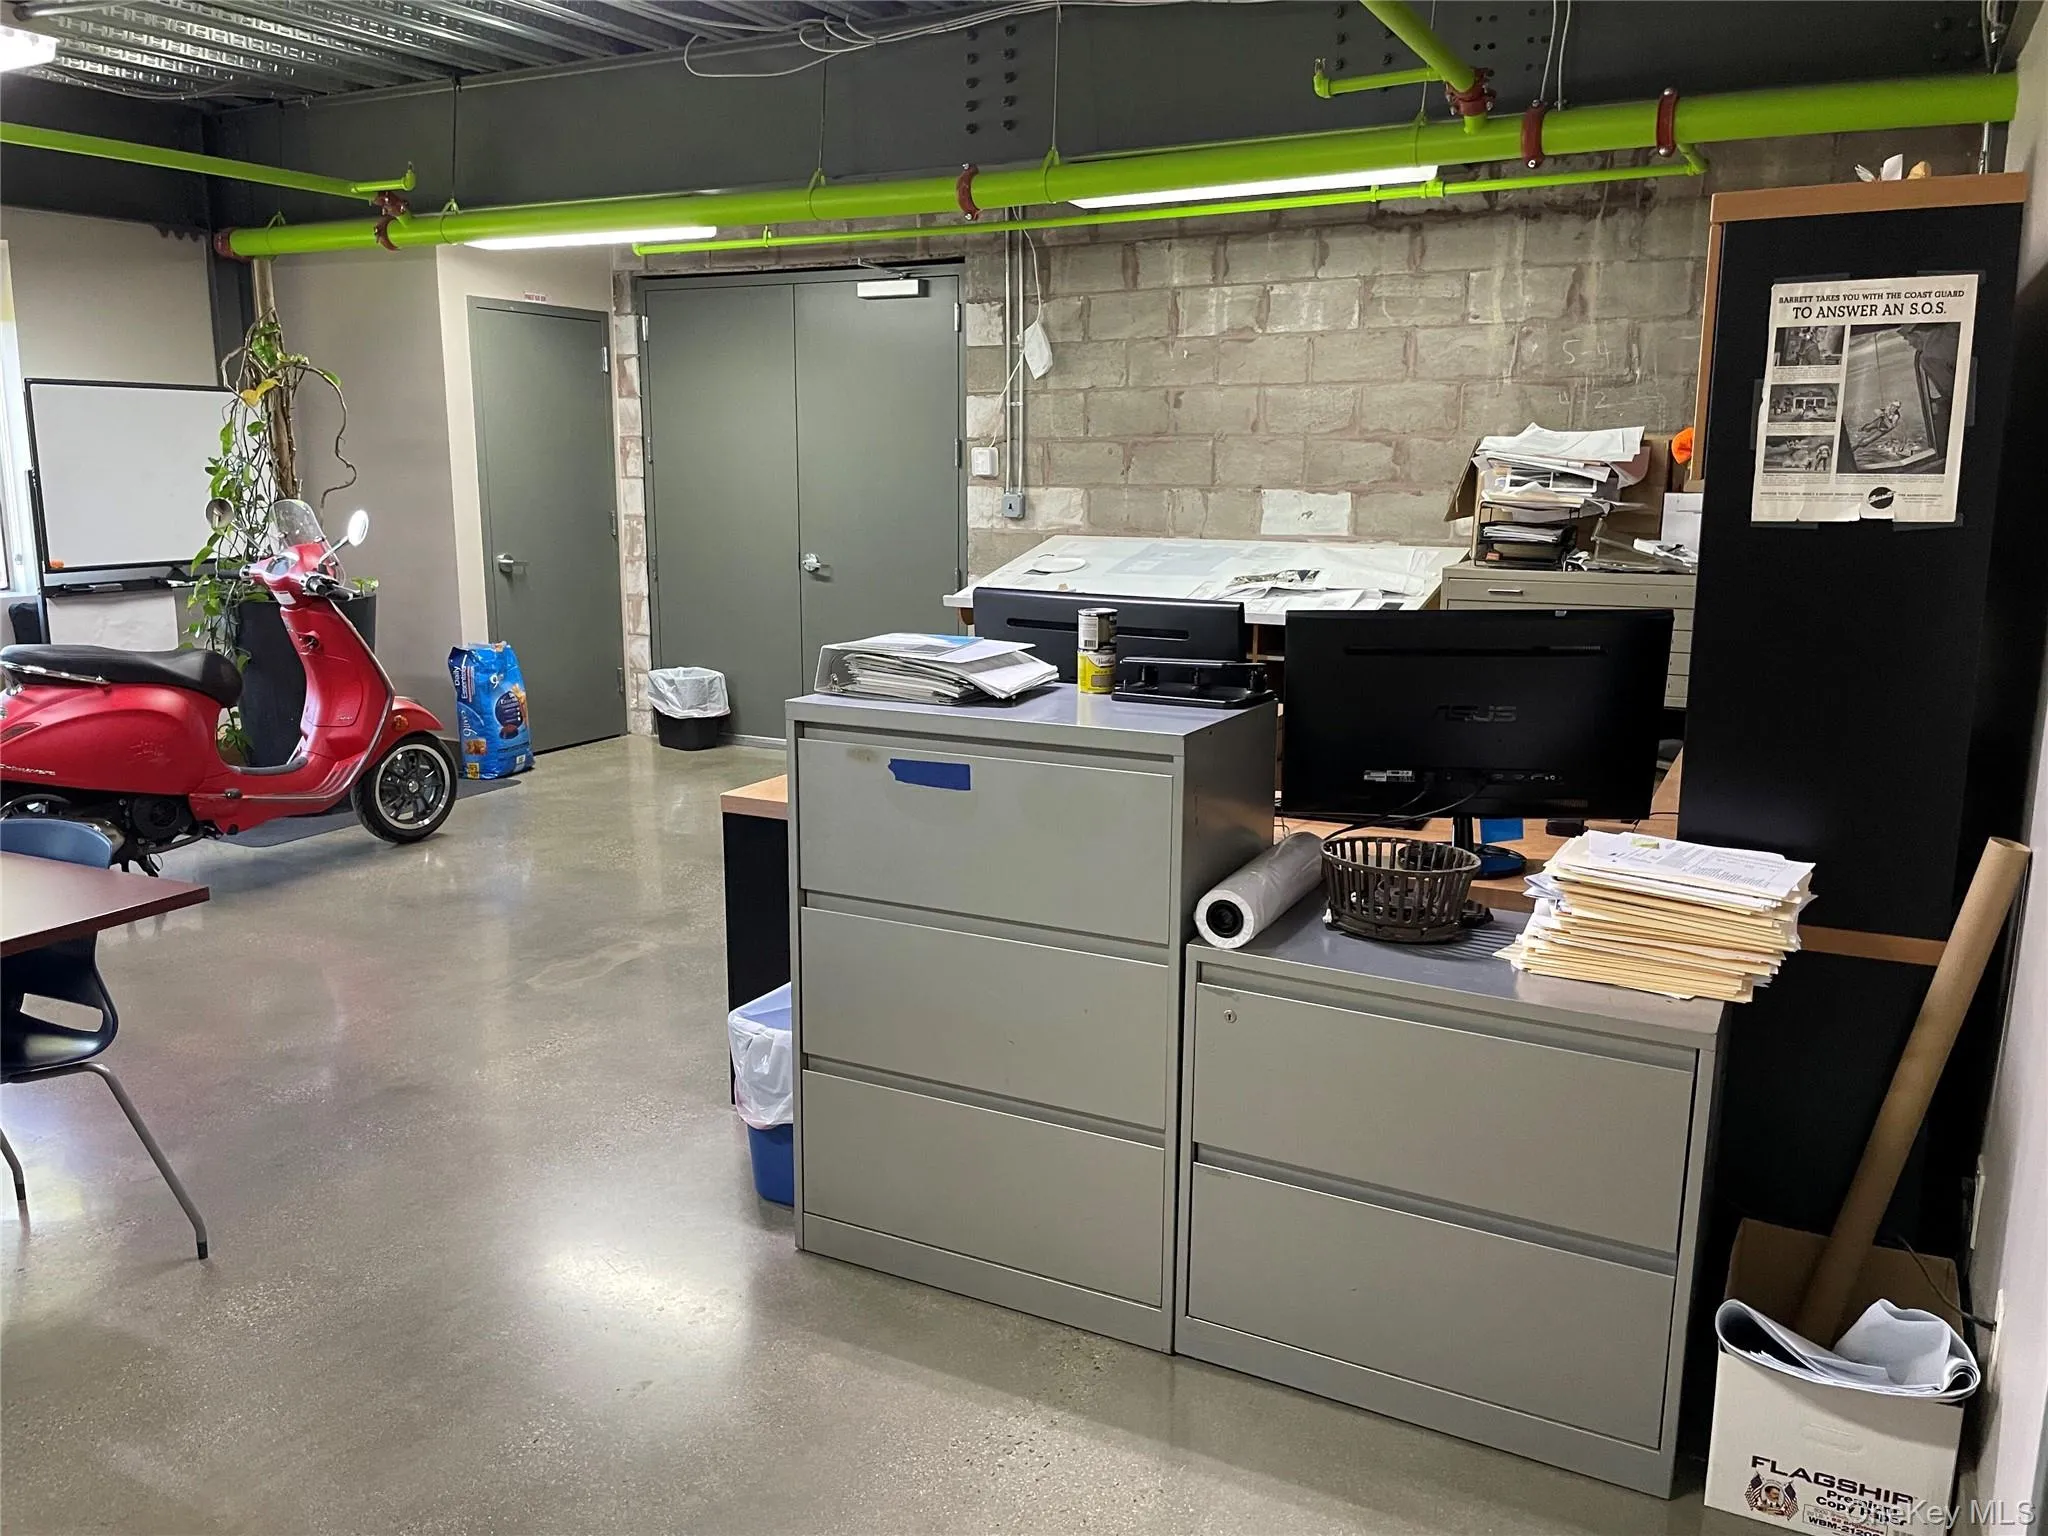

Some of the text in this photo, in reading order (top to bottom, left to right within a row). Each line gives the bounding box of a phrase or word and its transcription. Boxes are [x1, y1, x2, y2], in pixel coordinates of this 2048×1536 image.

[1778, 290, 1965, 304] BARRETT TAKES YOU WITH THE COAST GUARD
[1792, 301, 1947, 320] TO ANSWER AN S.O.S.
[453, 666, 462, 686] Daily
[1431, 704, 1517, 722] ASUS
[1751, 1455, 1914, 1505] FLAGSHIP
[1816, 1496, 1855, 1515] Copy
